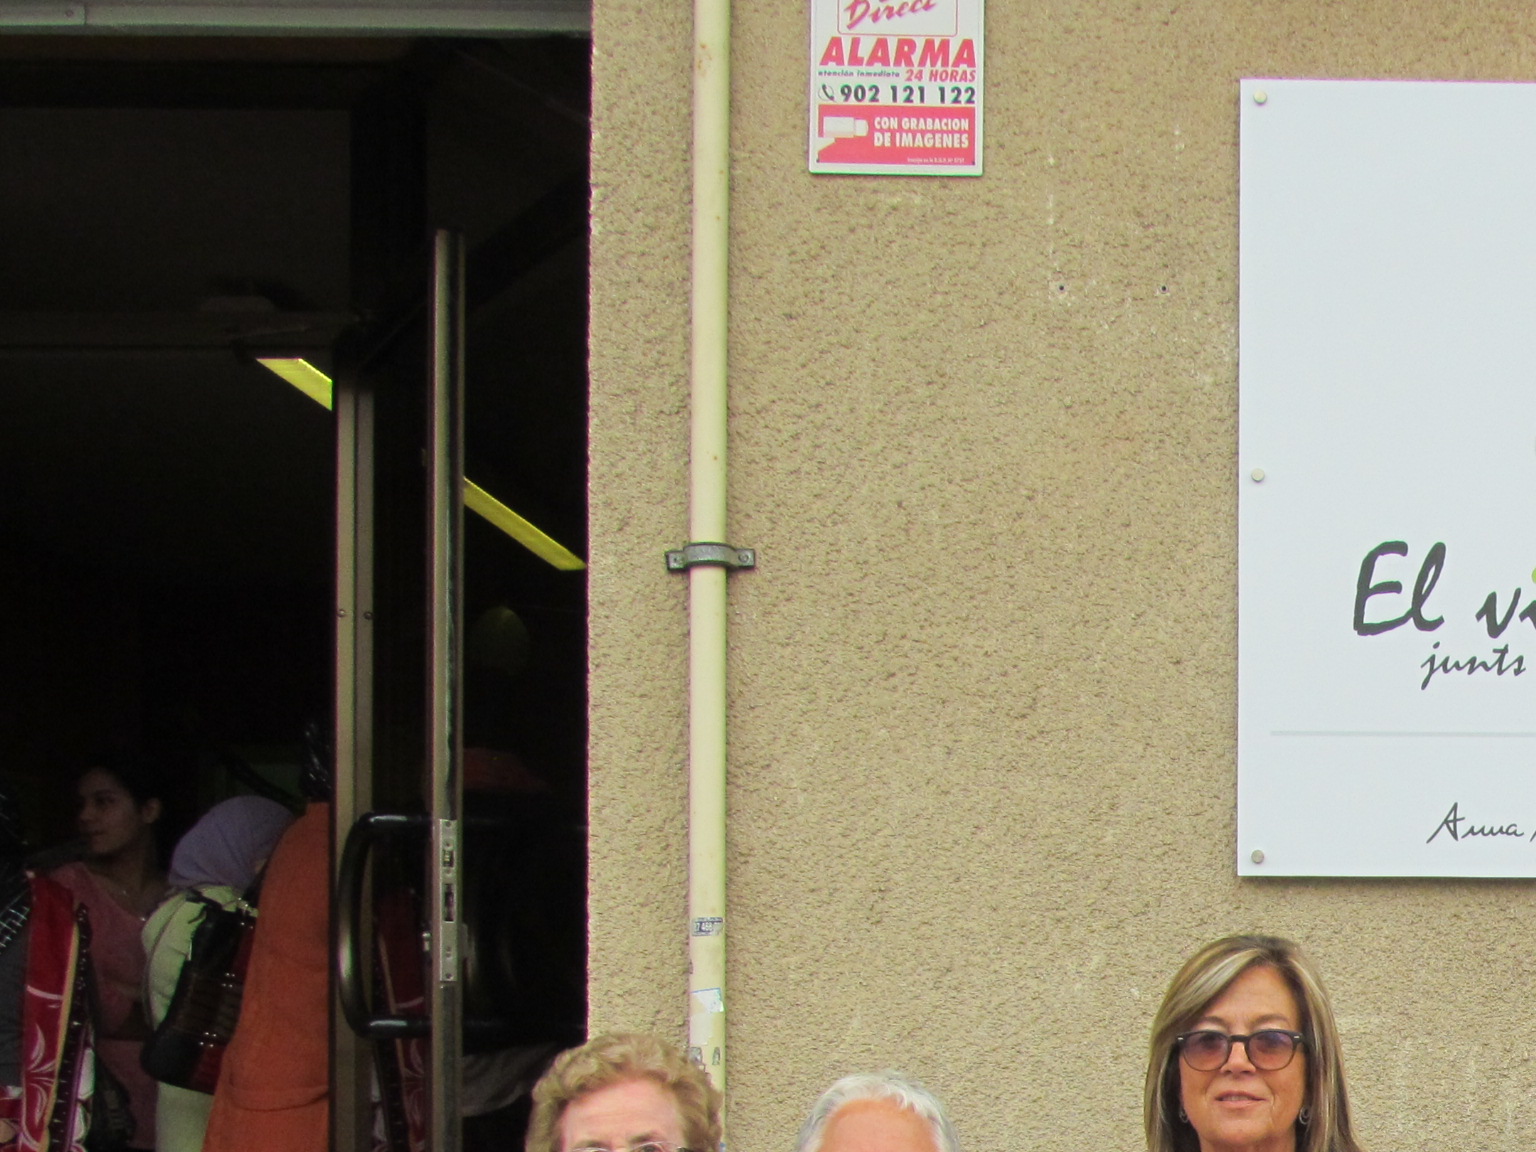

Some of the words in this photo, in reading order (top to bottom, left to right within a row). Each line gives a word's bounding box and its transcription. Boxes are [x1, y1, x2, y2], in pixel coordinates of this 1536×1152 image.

[819, 36, 976, 68] ALARMA
[857, 69, 900, 78] inmediata
[905, 69, 923, 82] 24
[929, 69, 976, 82] HORAS
[840, 84, 880, 103] 902
[890, 85, 926, 104] 121
[938, 86, 976, 104] 122
[874, 117, 898, 130] CON
[901, 118, 969, 131] GRABACION
[874, 132, 891, 147] DE
[895, 132, 969, 148] IMAGENES
[1353, 540, 1447, 637] El
[1420, 642, 1527, 690] junts
[1426, 802, 1525, 844] Anna
